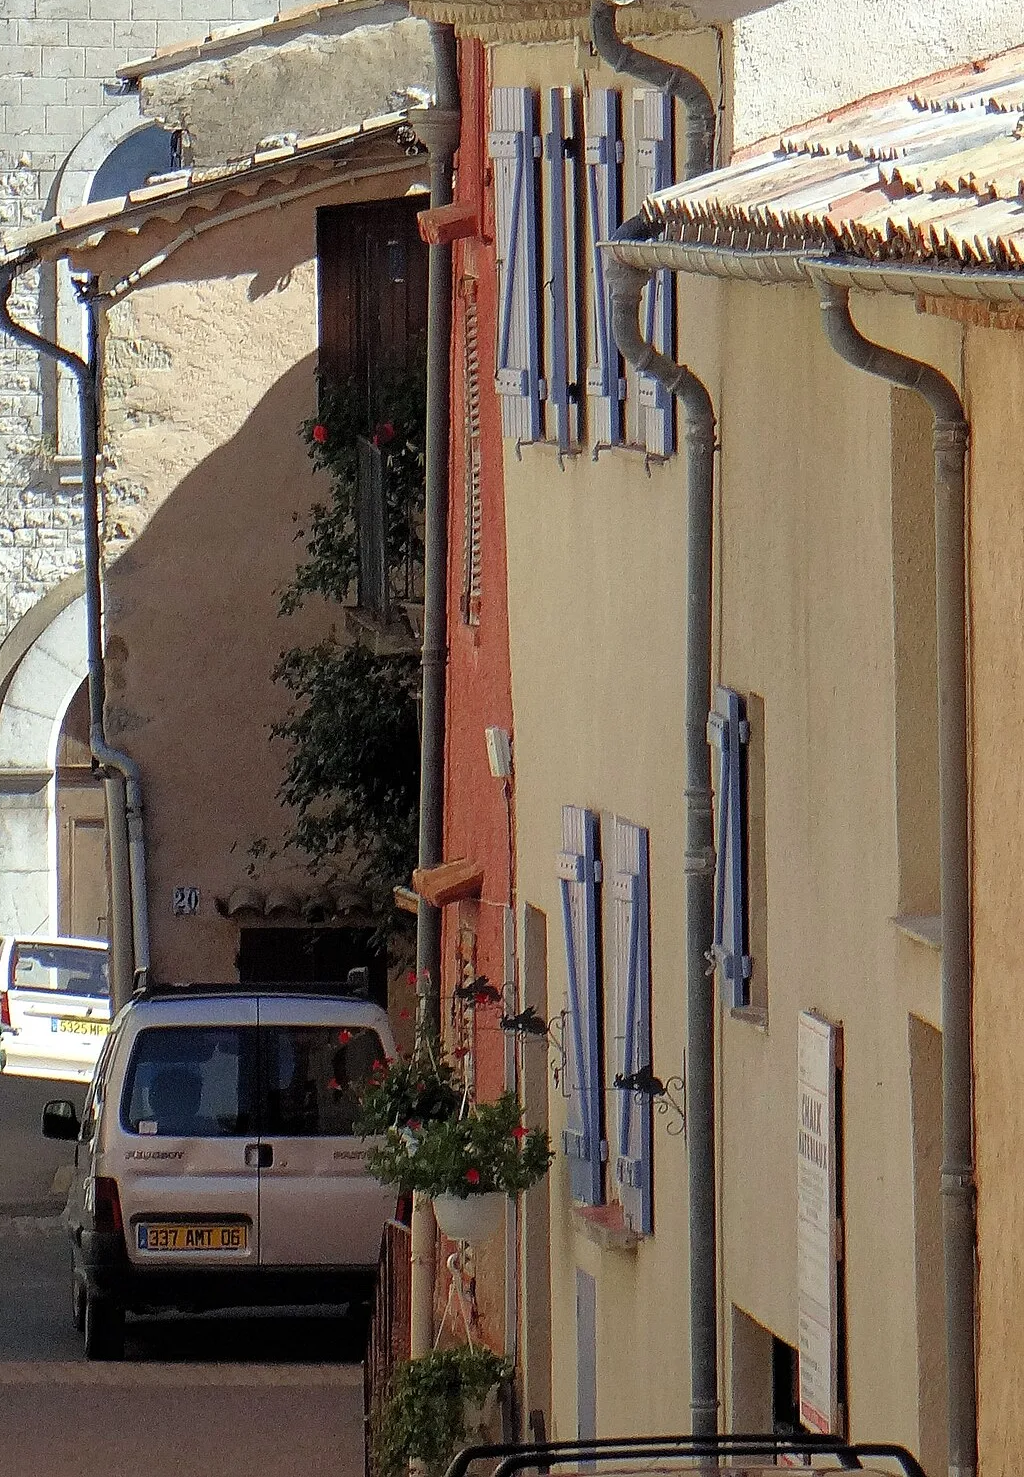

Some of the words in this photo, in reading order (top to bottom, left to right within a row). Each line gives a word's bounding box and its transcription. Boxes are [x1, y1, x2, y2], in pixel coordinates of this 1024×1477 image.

[176, 888, 199, 911] 20
[149, 1229, 178, 1246] 337
[186, 1229, 214, 1246] AMT
[221, 1229, 240, 1246] 06
